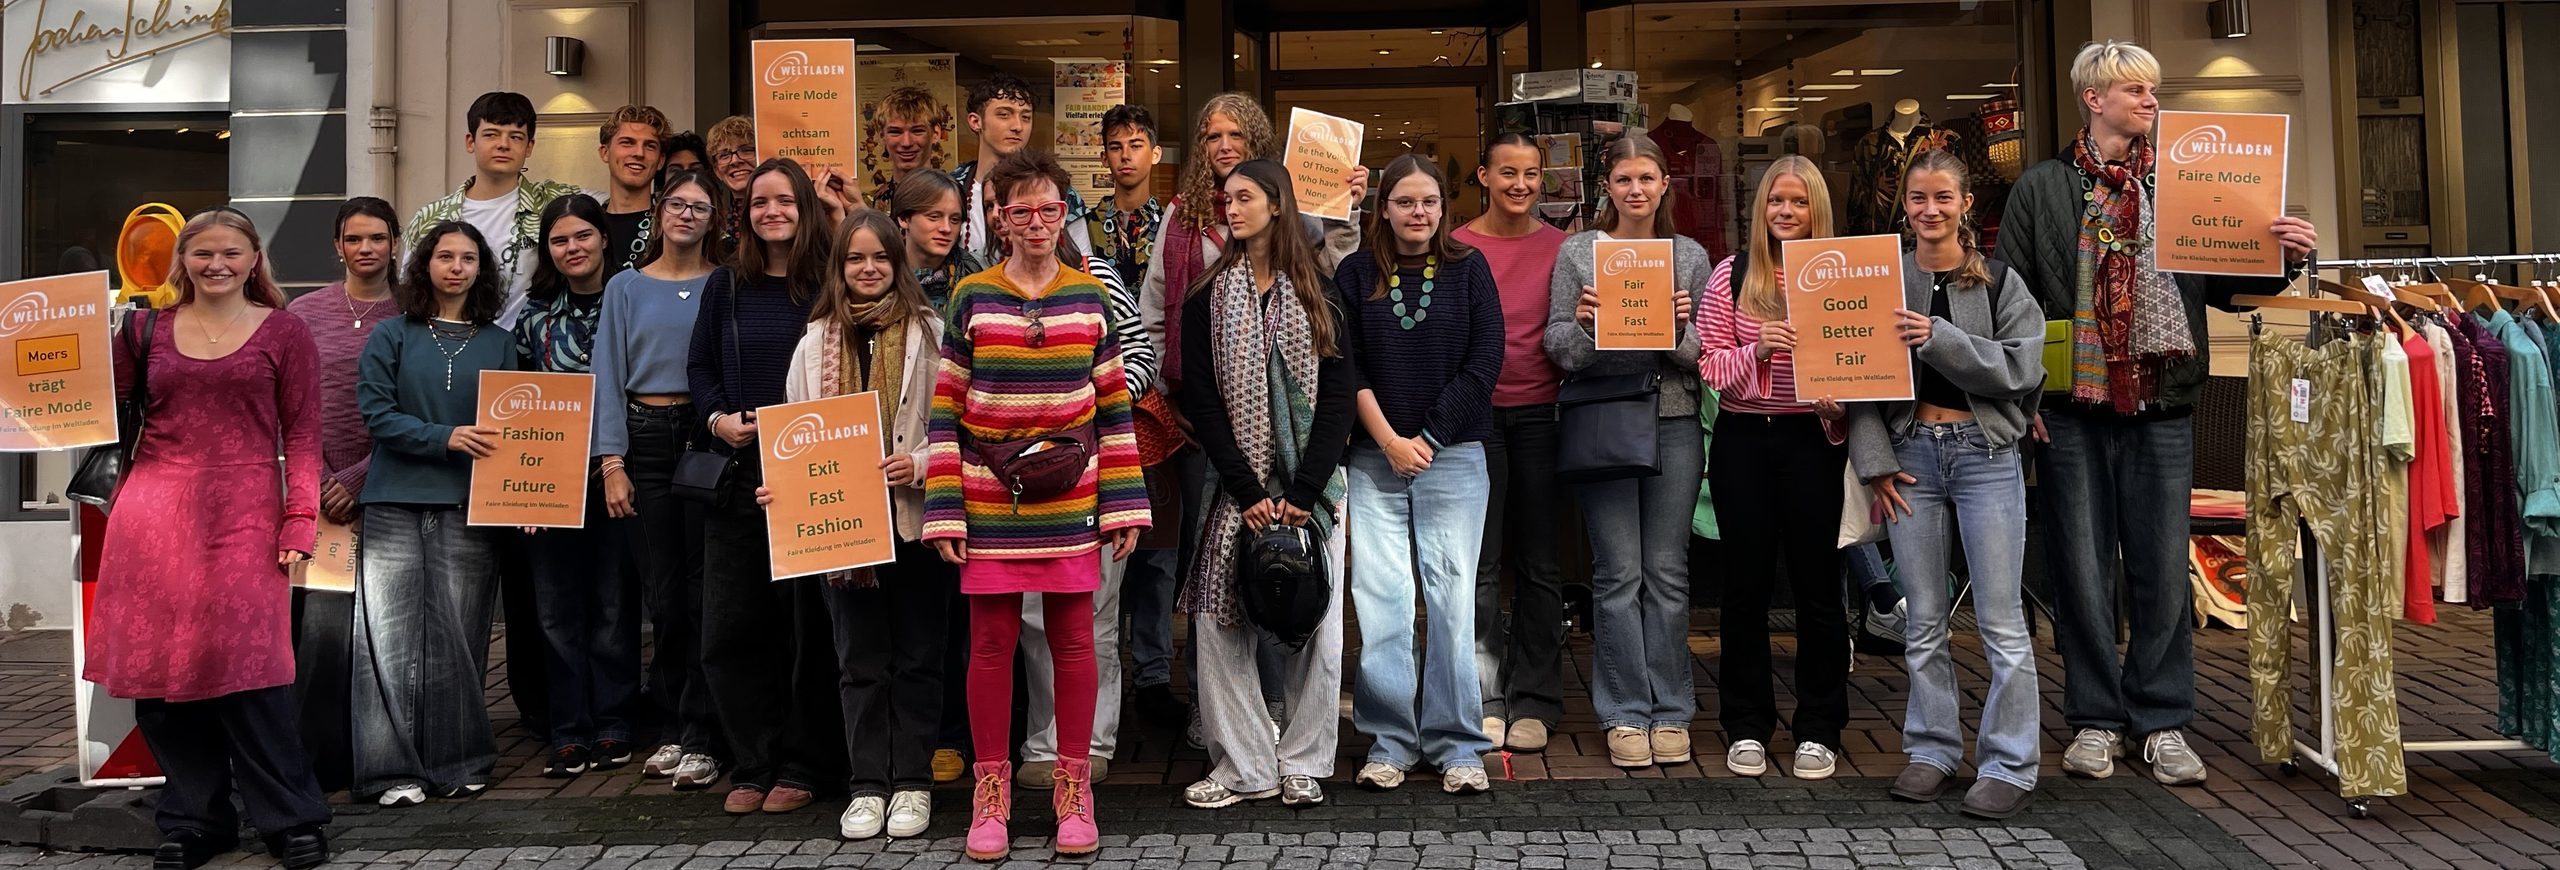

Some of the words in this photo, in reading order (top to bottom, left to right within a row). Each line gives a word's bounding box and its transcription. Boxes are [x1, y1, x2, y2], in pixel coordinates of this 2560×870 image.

[20, 0, 123, 101] Jochen
[781, 65, 845, 76] WELTLADEN
[772, 91, 800, 101] Faire
[803, 90, 838, 100] Mode
[1065, 111, 1088, 119] Vielfalt
[1089, 111, 1105, 119] erleb
[782, 128, 830, 139] achtsam
[779, 146, 835, 157] einkaufen
[1298, 146, 1309, 154] Be
[1310, 148, 1325, 158] the
[2191, 141, 2272, 156] WELTLADEN
[1303, 160, 1313, 169] Of
[1315, 162, 1340, 175] Those
[1298, 174, 1318, 185] Who
[1319, 177, 1340, 189] have
[2178, 170, 2213, 182] Faire
[2218, 171, 2261, 184] Mode
[1305, 188, 1328, 199] None
[2192, 214, 2218, 227] Gut
[2222, 216, 2244, 228] für
[2176, 235, 2197, 247] die
[2202, 237, 2260, 250] Umwelt
[1616, 259, 1665, 268] WELTLADEN
[2189, 255, 2218, 263] Kleidung
[1815, 265, 1890, 280] WELTLADEN
[1624, 280, 1645, 289] Fair
[1621, 298, 1648, 308] Statt
[1823, 295, 1868, 311] Good
[13, 303, 96, 324] WELTLADEN
[1624, 316, 1647, 326] Fast
[1822, 325, 1875, 339] Better
[28, 350, 68, 363] Moers
[1835, 351, 1867, 366] Fair
[28, 378, 66, 394] trägt
[1826, 375, 1853, 383] Kleidung
[4, 405, 43, 418] Faire
[47, 399, 92, 415] Mode
[510, 399, 582, 412] WELTLADEN
[502, 426, 565, 442] Fashion
[792, 423, 869, 446] WELTLADEN
[519, 452, 544, 467] for
[808, 459, 840, 477] Exit
[502, 479, 556, 493] Future
[809, 488, 845, 507] Fast
[796, 517, 863, 538] Fashion
[328, 542, 341, 559] for
[787, 548, 803, 557] Faire
[804, 543, 833, 554] Kleidung
[843, 537, 876, 548] Weltladen
